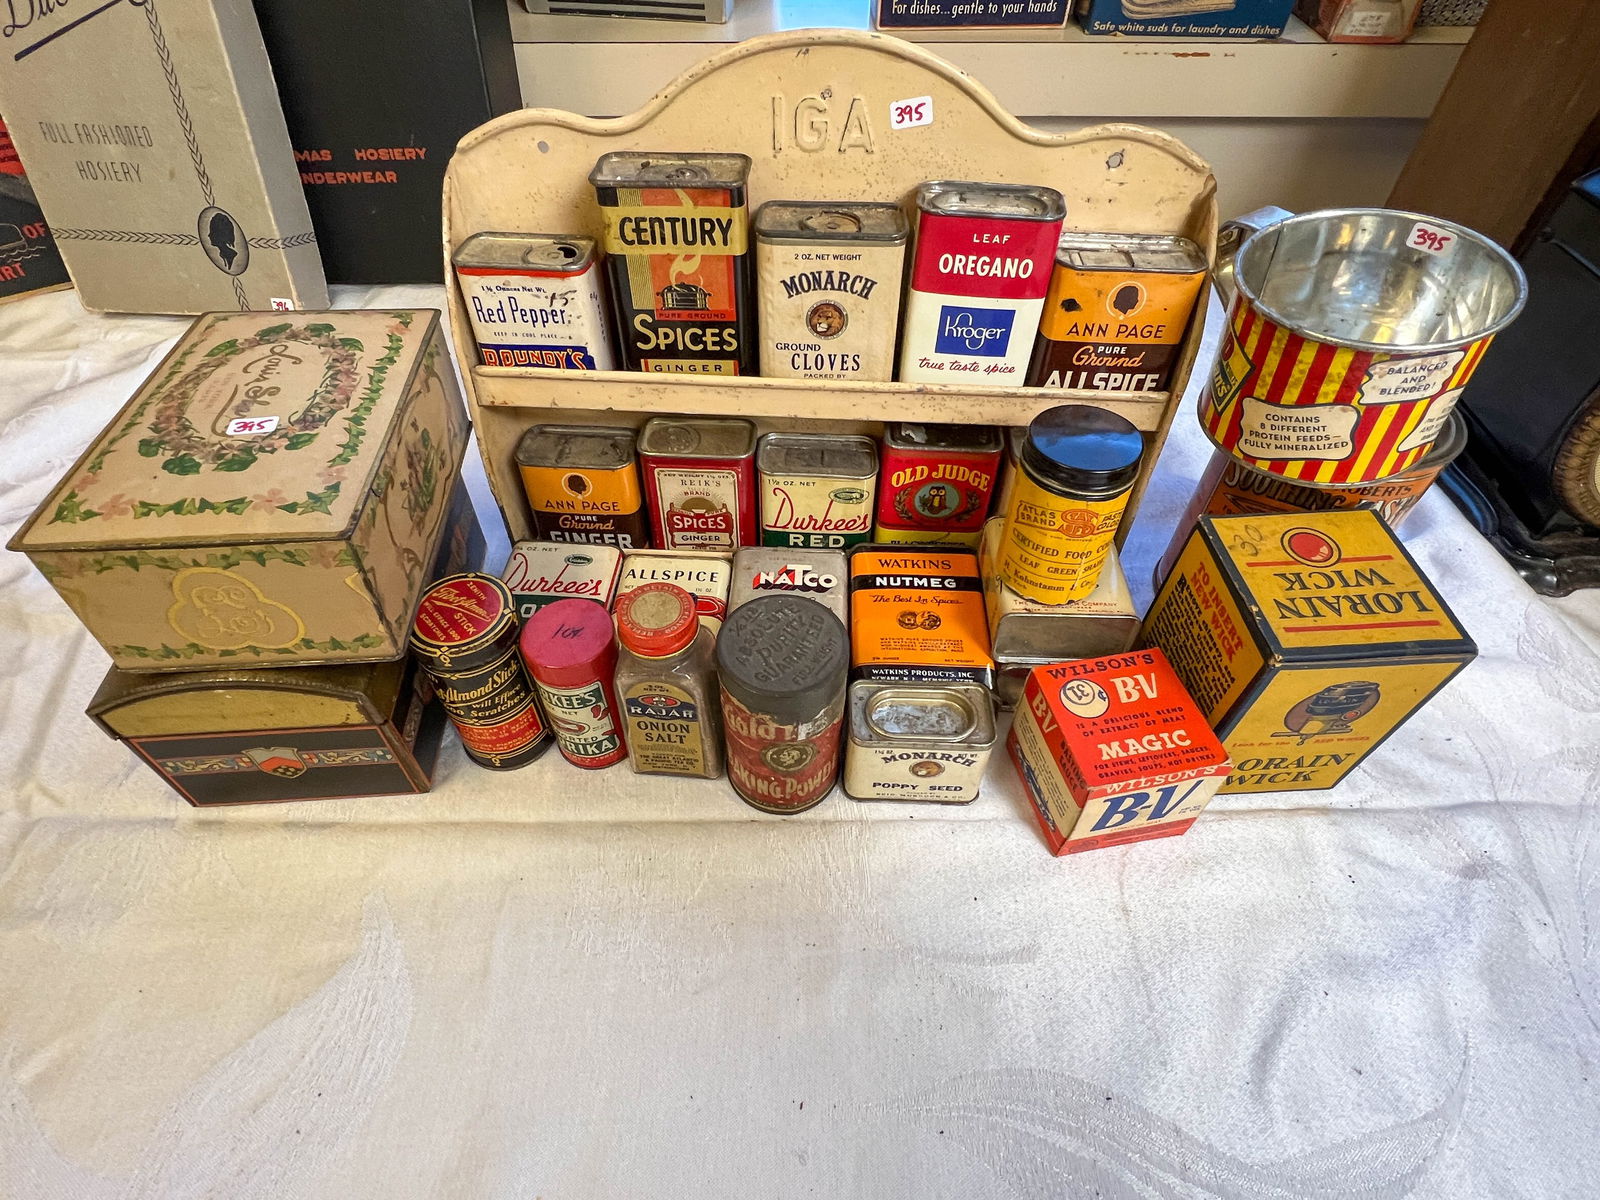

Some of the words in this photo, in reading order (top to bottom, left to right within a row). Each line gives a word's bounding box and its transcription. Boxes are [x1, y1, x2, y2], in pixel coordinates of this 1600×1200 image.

[892, 1, 907, 16] For
[988, 3, 999, 15] to
[1002, 3, 1022, 17] your
[1025, 0, 1058, 14] hands
[1093, 21, 1115, 32] Safe
[1118, 22, 1145, 33] white
[1147, 22, 1168, 33] suds
[1171, 23, 1186, 33] for
[1187, 23, 1225, 36] laundry
[1228, 24, 1248, 35] and
[1251, 25, 1280, 36] dishes
[895, 102, 927, 124] 395
[771, 96, 875, 154] IGA
[39, 121, 74, 145] FULL
[75, 122, 154, 148] FASHIONED
[354, 147, 427, 161] HOSIERY
[76, 160, 142, 185] HOSIERY
[300, 171, 398, 185] NDERWEAR
[22, 222, 46, 239] OF
[618, 216, 733, 247] CENTURY
[973, 233, 1011, 245] LEAF
[1413, 228, 1452, 251] 395
[938, 253, 1034, 279] OREGANO
[780, 270, 878, 300] MONARCH
[472, 296, 507, 324] Red
[508, 296, 566, 328] Pepper
[659, 312, 684, 320] PURE
[687, 312, 726, 320] GROUND
[634, 313, 738, 351] SPICES
[945, 312, 1006, 350] Kroger
[1067, 322, 1109, 337] ANN
[1116, 323, 1166, 339] PAGE
[775, 342, 821, 352] GROUND
[1097, 346, 1128, 355] PURE
[791, 353, 860, 372] CLOVES
[1072, 345, 1145, 368] Ground
[654, 364, 723, 373] GINGER
[919, 357, 945, 371] true
[949, 359, 980, 373] taste
[983, 362, 1016, 376] spice
[1386, 361, 1448, 375] BALANCED
[1400, 375, 1427, 384] AND
[1378, 382, 1435, 396] BLENDED!
[233, 419, 274, 433] 395
[1265, 414, 1321, 423] CONTAINS
[1249, 430, 1291, 441] PROTEIN
[1260, 422, 1266, 431] 8
[1270, 424, 1327, 433] DIFFERENT
[1244, 439, 1271, 450] FULLY
[1274, 440, 1349, 452] MINERALIZED
[681, 479, 721, 487] REIK'S
[891, 465, 929, 488] OLD
[931, 464, 990, 492] JUDGE
[545, 499, 575, 511] ANN
[582, 500, 621, 512] PAGE
[766, 487, 869, 532] Durkee's
[1023, 504, 1056, 519] ATLAS
[559, 514, 615, 530] Ground
[673, 515, 726, 529] SPICES
[1021, 511, 1056, 527] BRAND
[789, 534, 845, 548] RED
[1013, 527, 1059, 557] CERTIFIED
[1064, 550, 1092, 560] FOOD
[877, 558, 952, 570] WATKINS
[1019, 554, 1040, 569] LEAF
[1047, 566, 1078, 575] GREEN
[506, 552, 603, 596] Durkee's
[625, 568, 719, 583] ALLSPICE
[754, 564, 838, 590] NATCO
[875, 576, 957, 588] NUTMEG
[1273, 568, 1395, 591] WICK
[870, 594, 889, 604] The
[891, 594, 913, 605] Best
[930, 596, 964, 606] Spices
[1198, 561, 1210, 587] TO
[1209, 586, 1244, 651] INSERT
[1273, 591, 1434, 619] LORAIN
[453, 612, 477, 635] STICK
[1190, 571, 1213, 611] NEW
[1210, 611, 1237, 664] WICK
[493, 662, 518, 688] Stick
[1046, 653, 1155, 680] WILSON'S
[1109, 672, 1158, 704] B-V
[470, 692, 525, 717] Scratches
[472, 699, 491, 708] will
[540, 688, 596, 708] RKEE'S
[630, 706, 694, 718] RAJAH
[1104, 712, 1150, 725] DELICIOUS
[1156, 706, 1184, 715] BLEND
[637, 720, 690, 734] ONION
[1100, 722, 1139, 734] EXTRACT
[1163, 715, 1186, 724] MEAT
[645, 732, 687, 744] SALT
[1097, 729, 1192, 761] MAGIC
[881, 752, 977, 767] MONARCH
[1185, 753, 1216, 764] DRINKS
[1233, 752, 1355, 771] ORAIN
[872, 782, 919, 790] POPPY
[1105, 764, 1219, 794] WILSON'S
[1225, 770, 1320, 786] WICK
[1090, 779, 1205, 833] B-V
